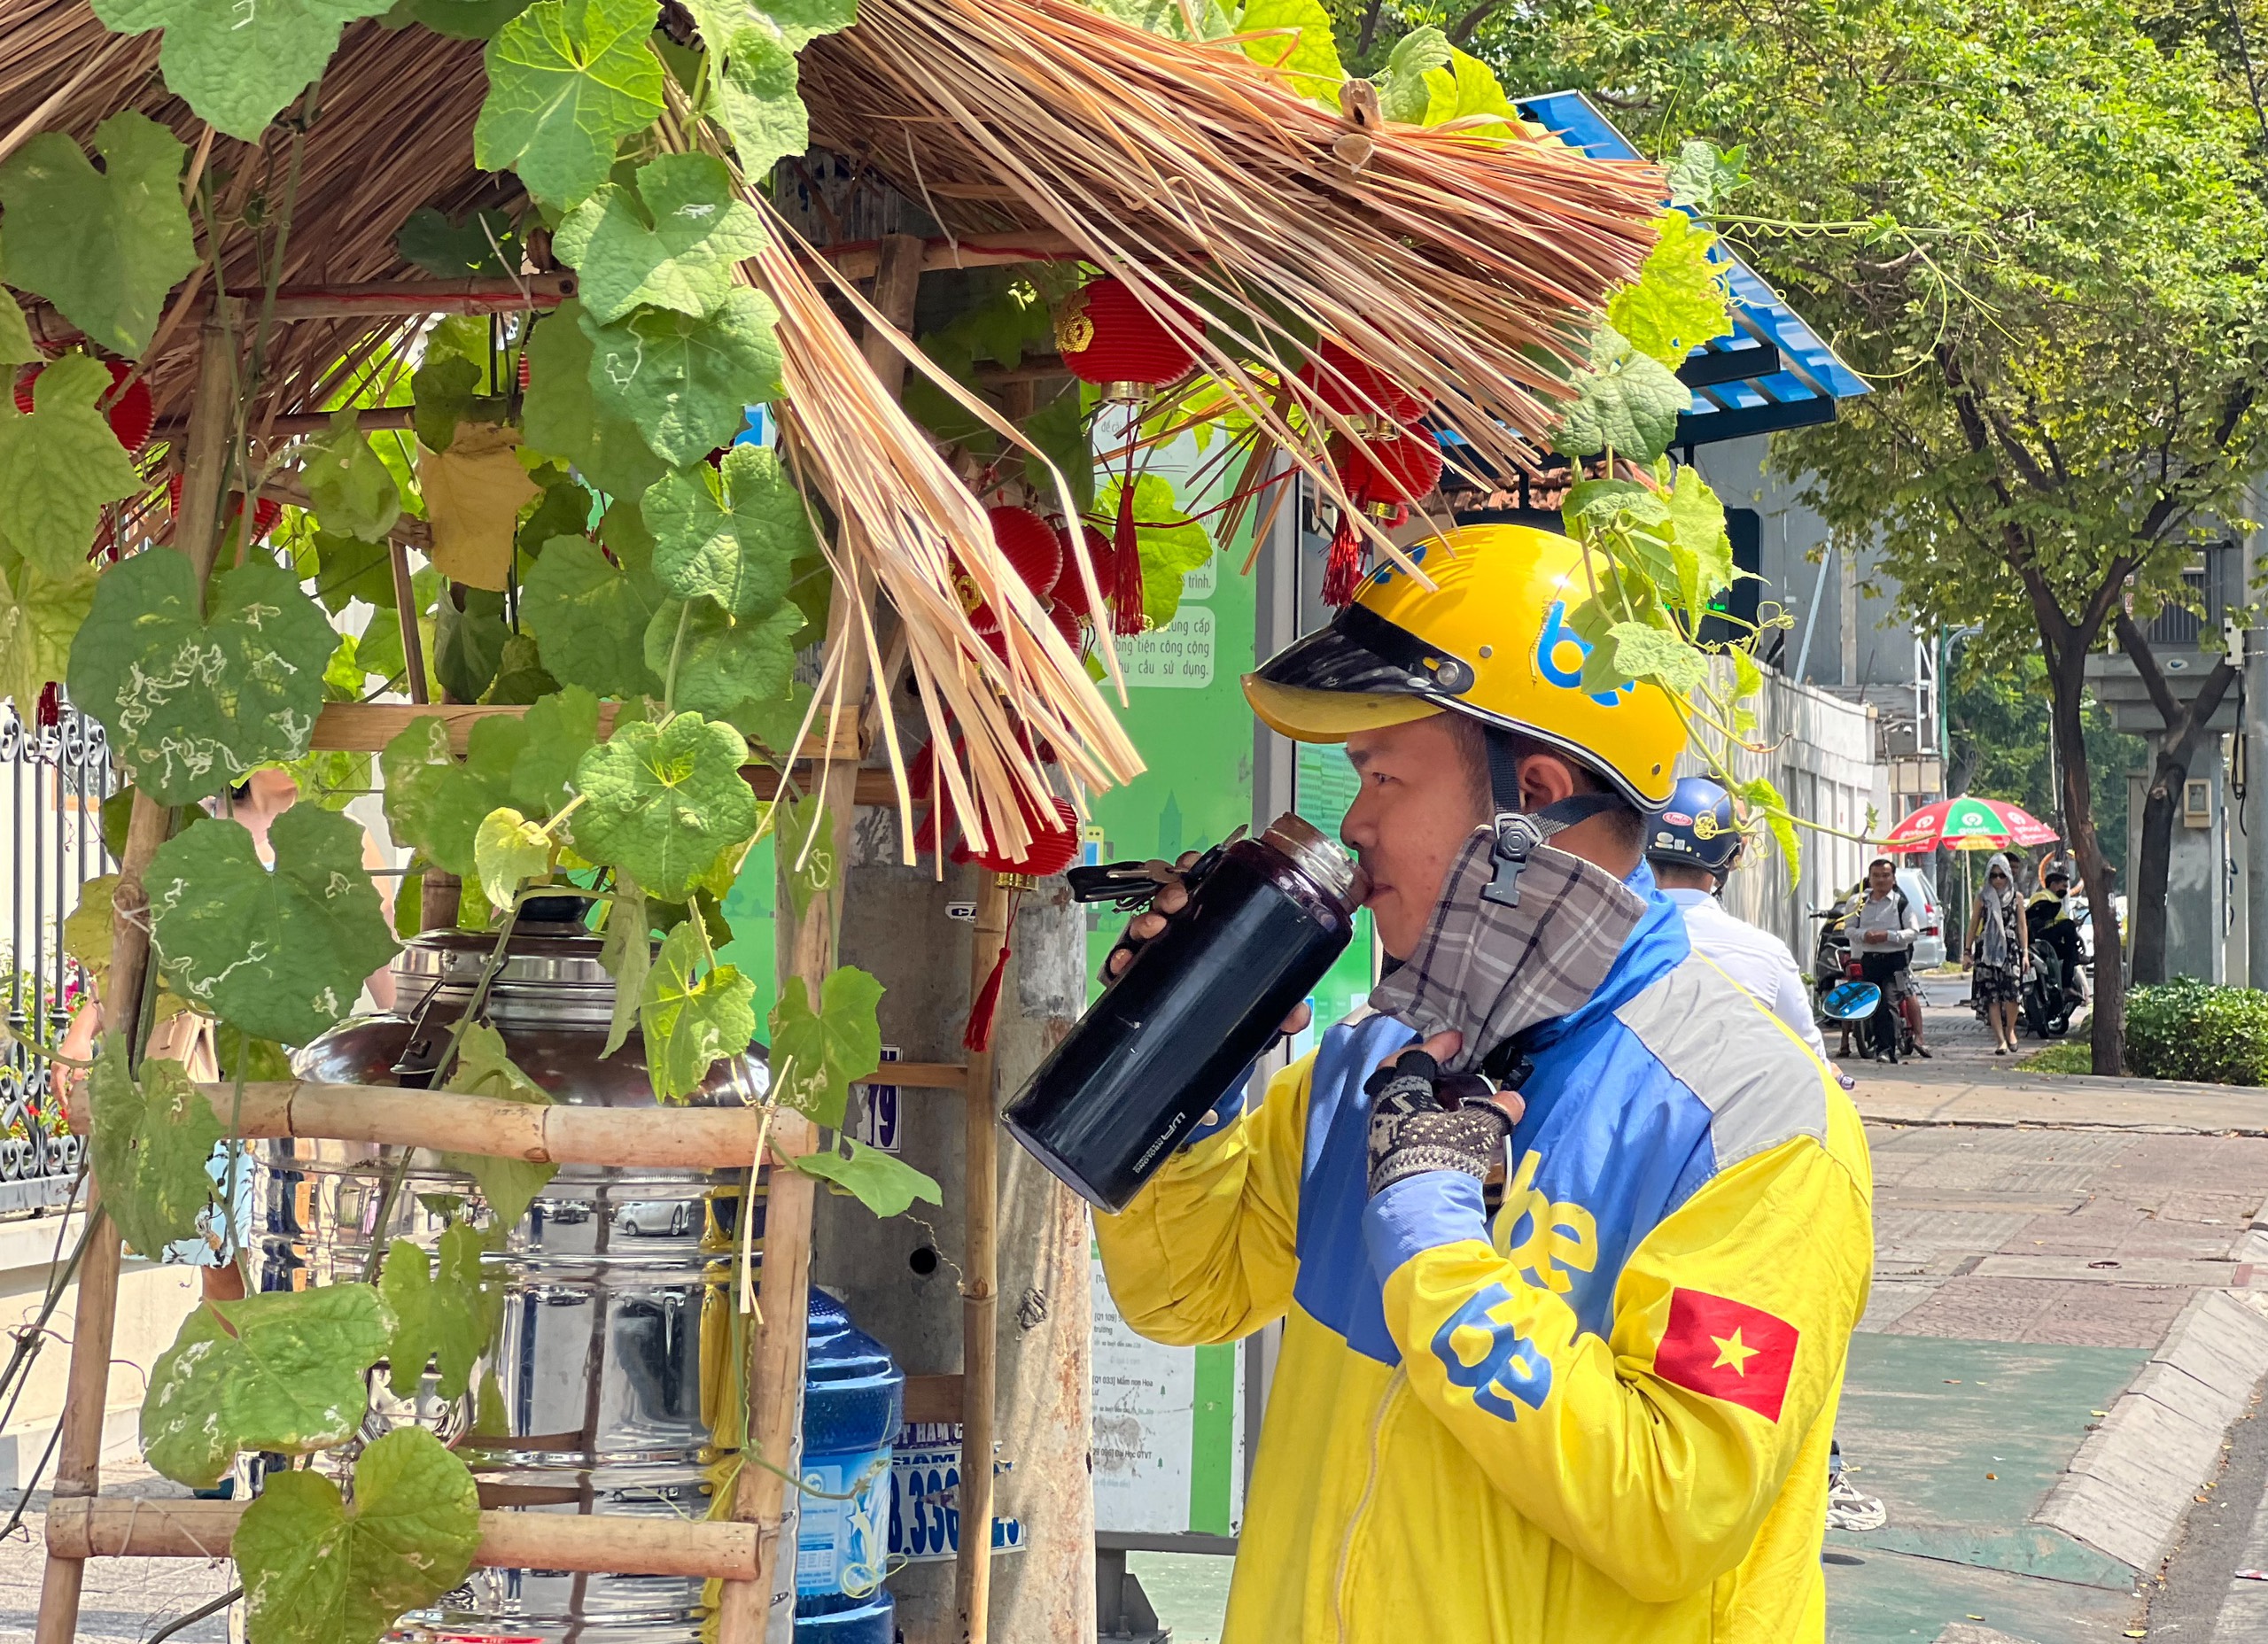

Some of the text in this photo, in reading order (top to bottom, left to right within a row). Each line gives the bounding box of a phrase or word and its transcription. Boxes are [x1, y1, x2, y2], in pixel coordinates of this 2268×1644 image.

[1188, 575, 1211, 589] trình.
[1193, 617, 1209, 635] cấp
[1138, 639, 1155, 655] tiện
[1161, 640, 1182, 657] công
[1187, 640, 1209, 657] cộng
[1183, 659, 1209, 679] dụng.
[1493, 1150, 1598, 1293] be
[1430, 1283, 1552, 1423] be
